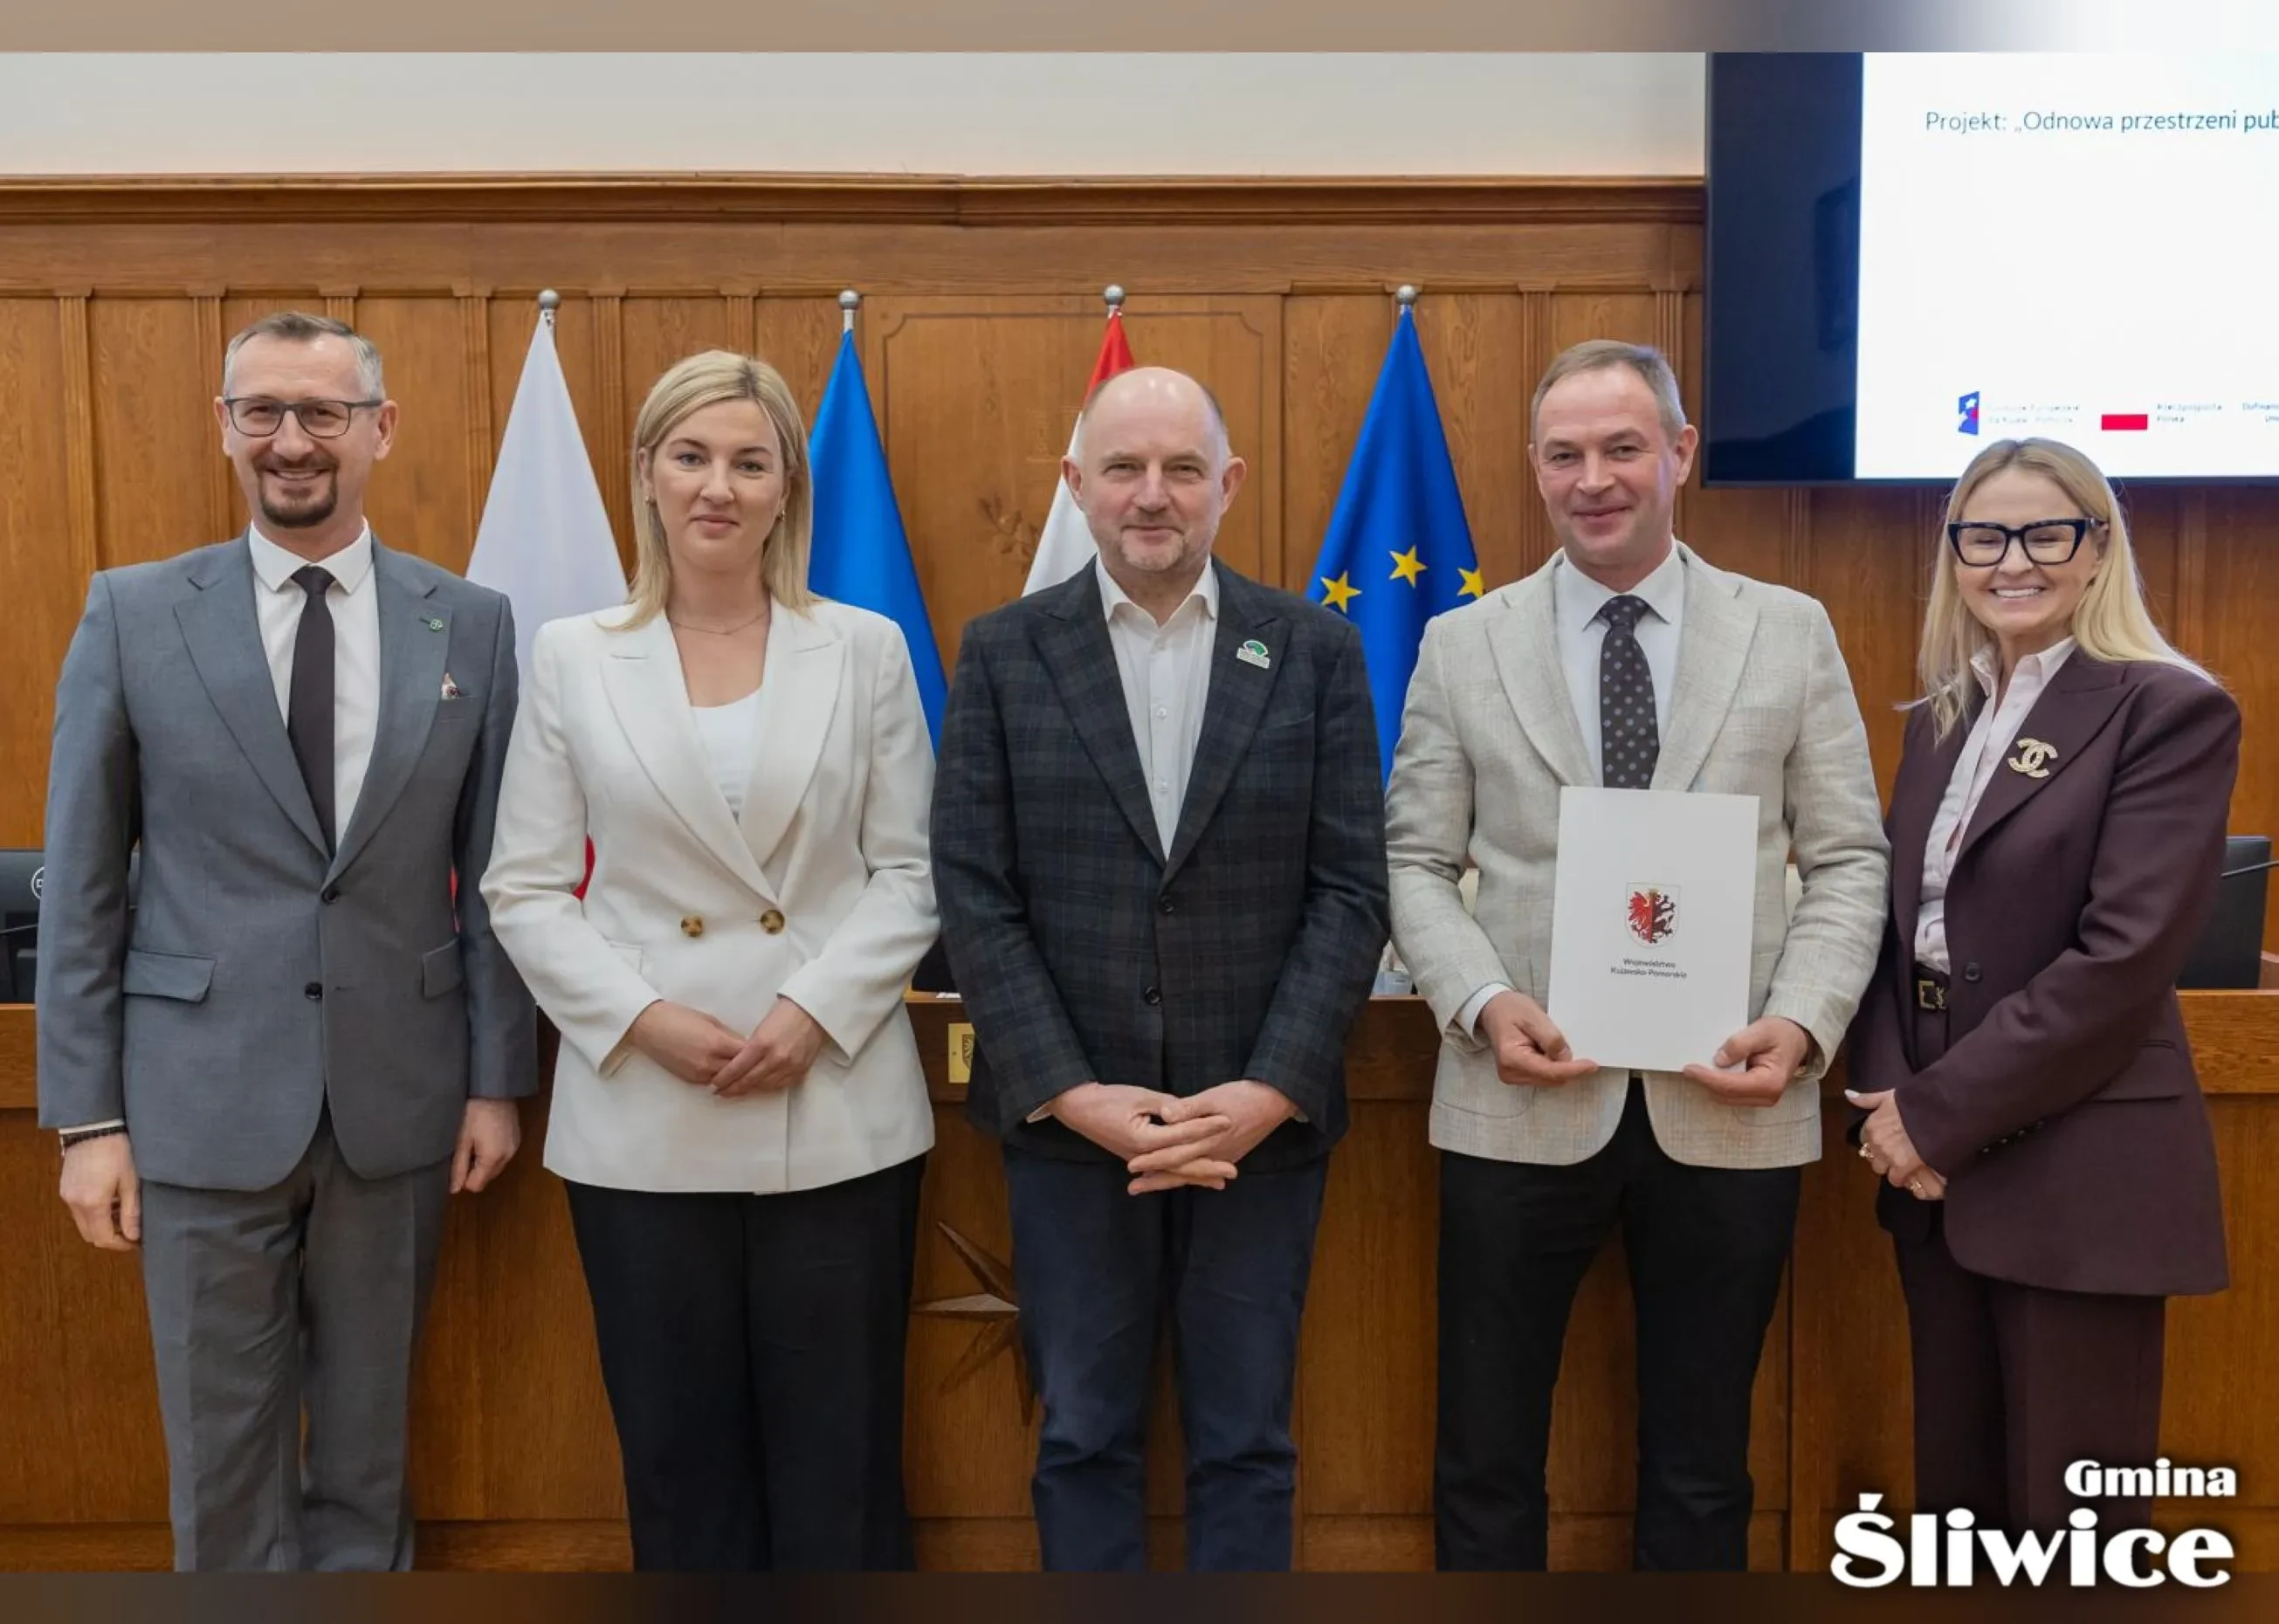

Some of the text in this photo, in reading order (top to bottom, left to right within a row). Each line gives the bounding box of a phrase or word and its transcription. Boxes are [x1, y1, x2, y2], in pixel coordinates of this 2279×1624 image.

[1926, 111, 2007, 134] Projekt:
[2014, 110, 2113, 132] „Odnowa
[2121, 109, 2236, 134] przestrzeni
